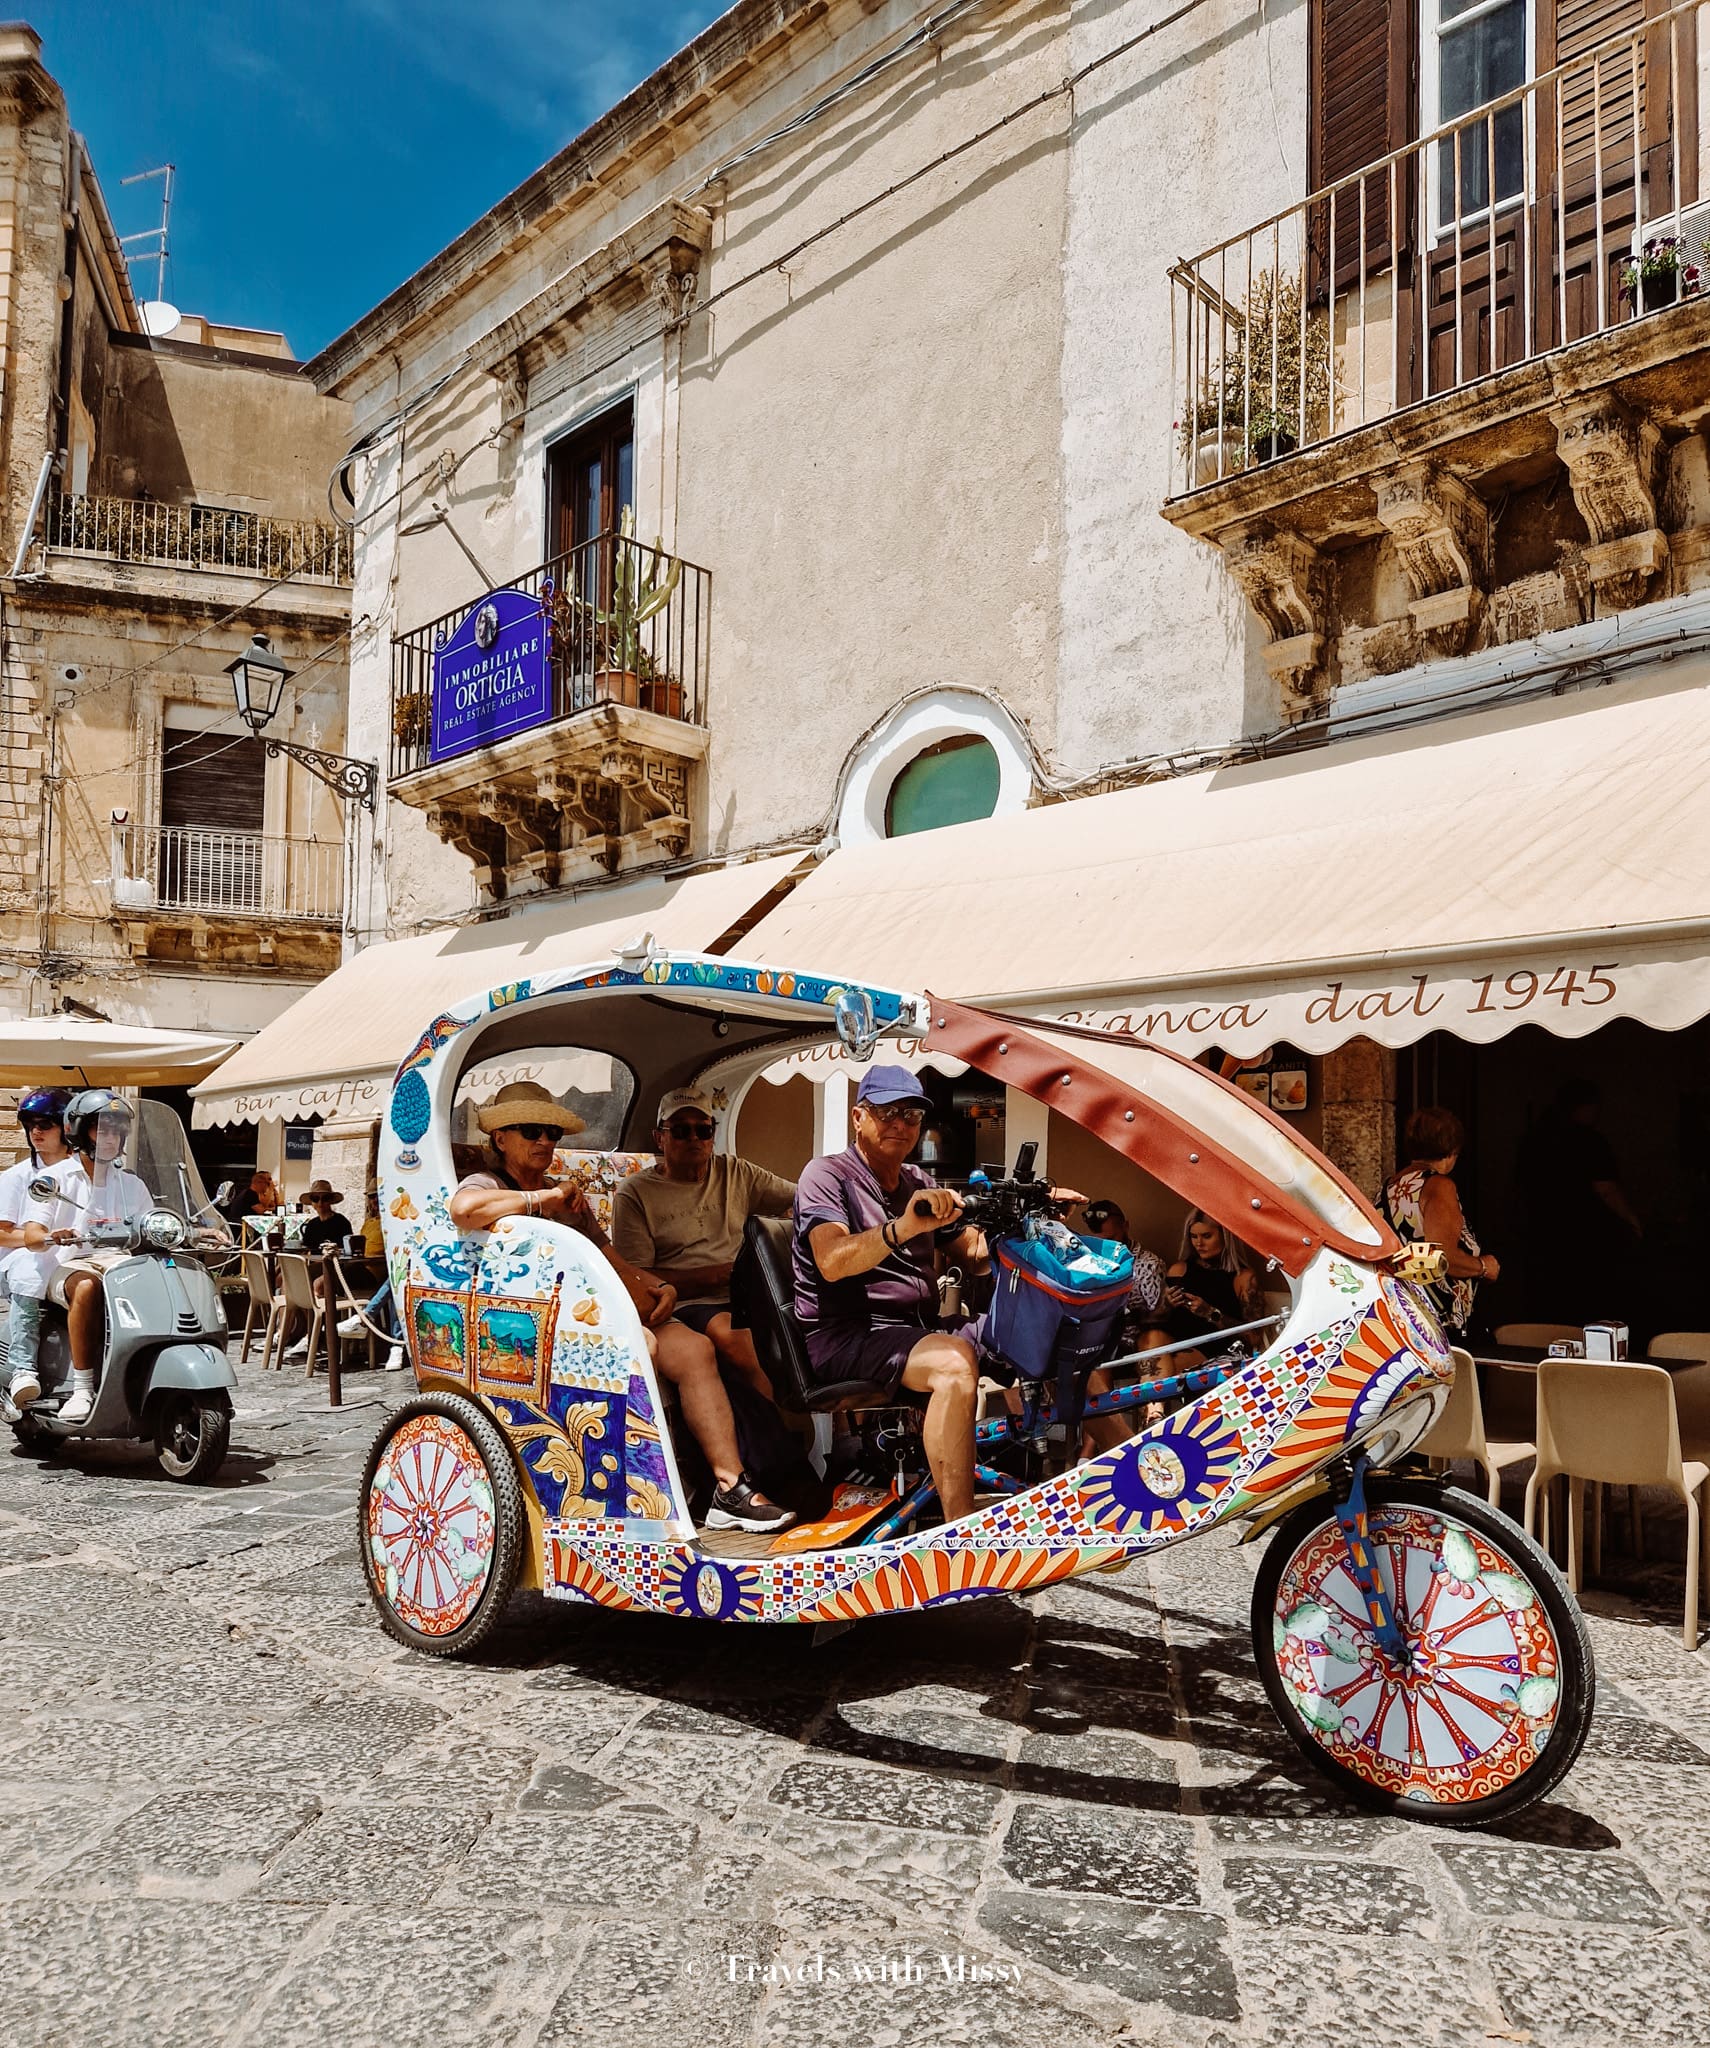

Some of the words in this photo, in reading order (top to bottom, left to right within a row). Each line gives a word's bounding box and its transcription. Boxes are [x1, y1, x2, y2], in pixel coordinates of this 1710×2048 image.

[444, 637, 539, 690] IMMOBILIARE
[455, 663, 525, 710] ORTIGIA
[443, 714, 464, 731] REAL
[466, 700, 497, 722] ESTATE
[499, 684, 537, 708] AGENCY
[1305, 974, 1444, 1025] dal
[1466, 962, 1619, 1015] 1945
[234, 1095, 281, 1114] Bar
[299, 1079, 381, 1107] Caffè
